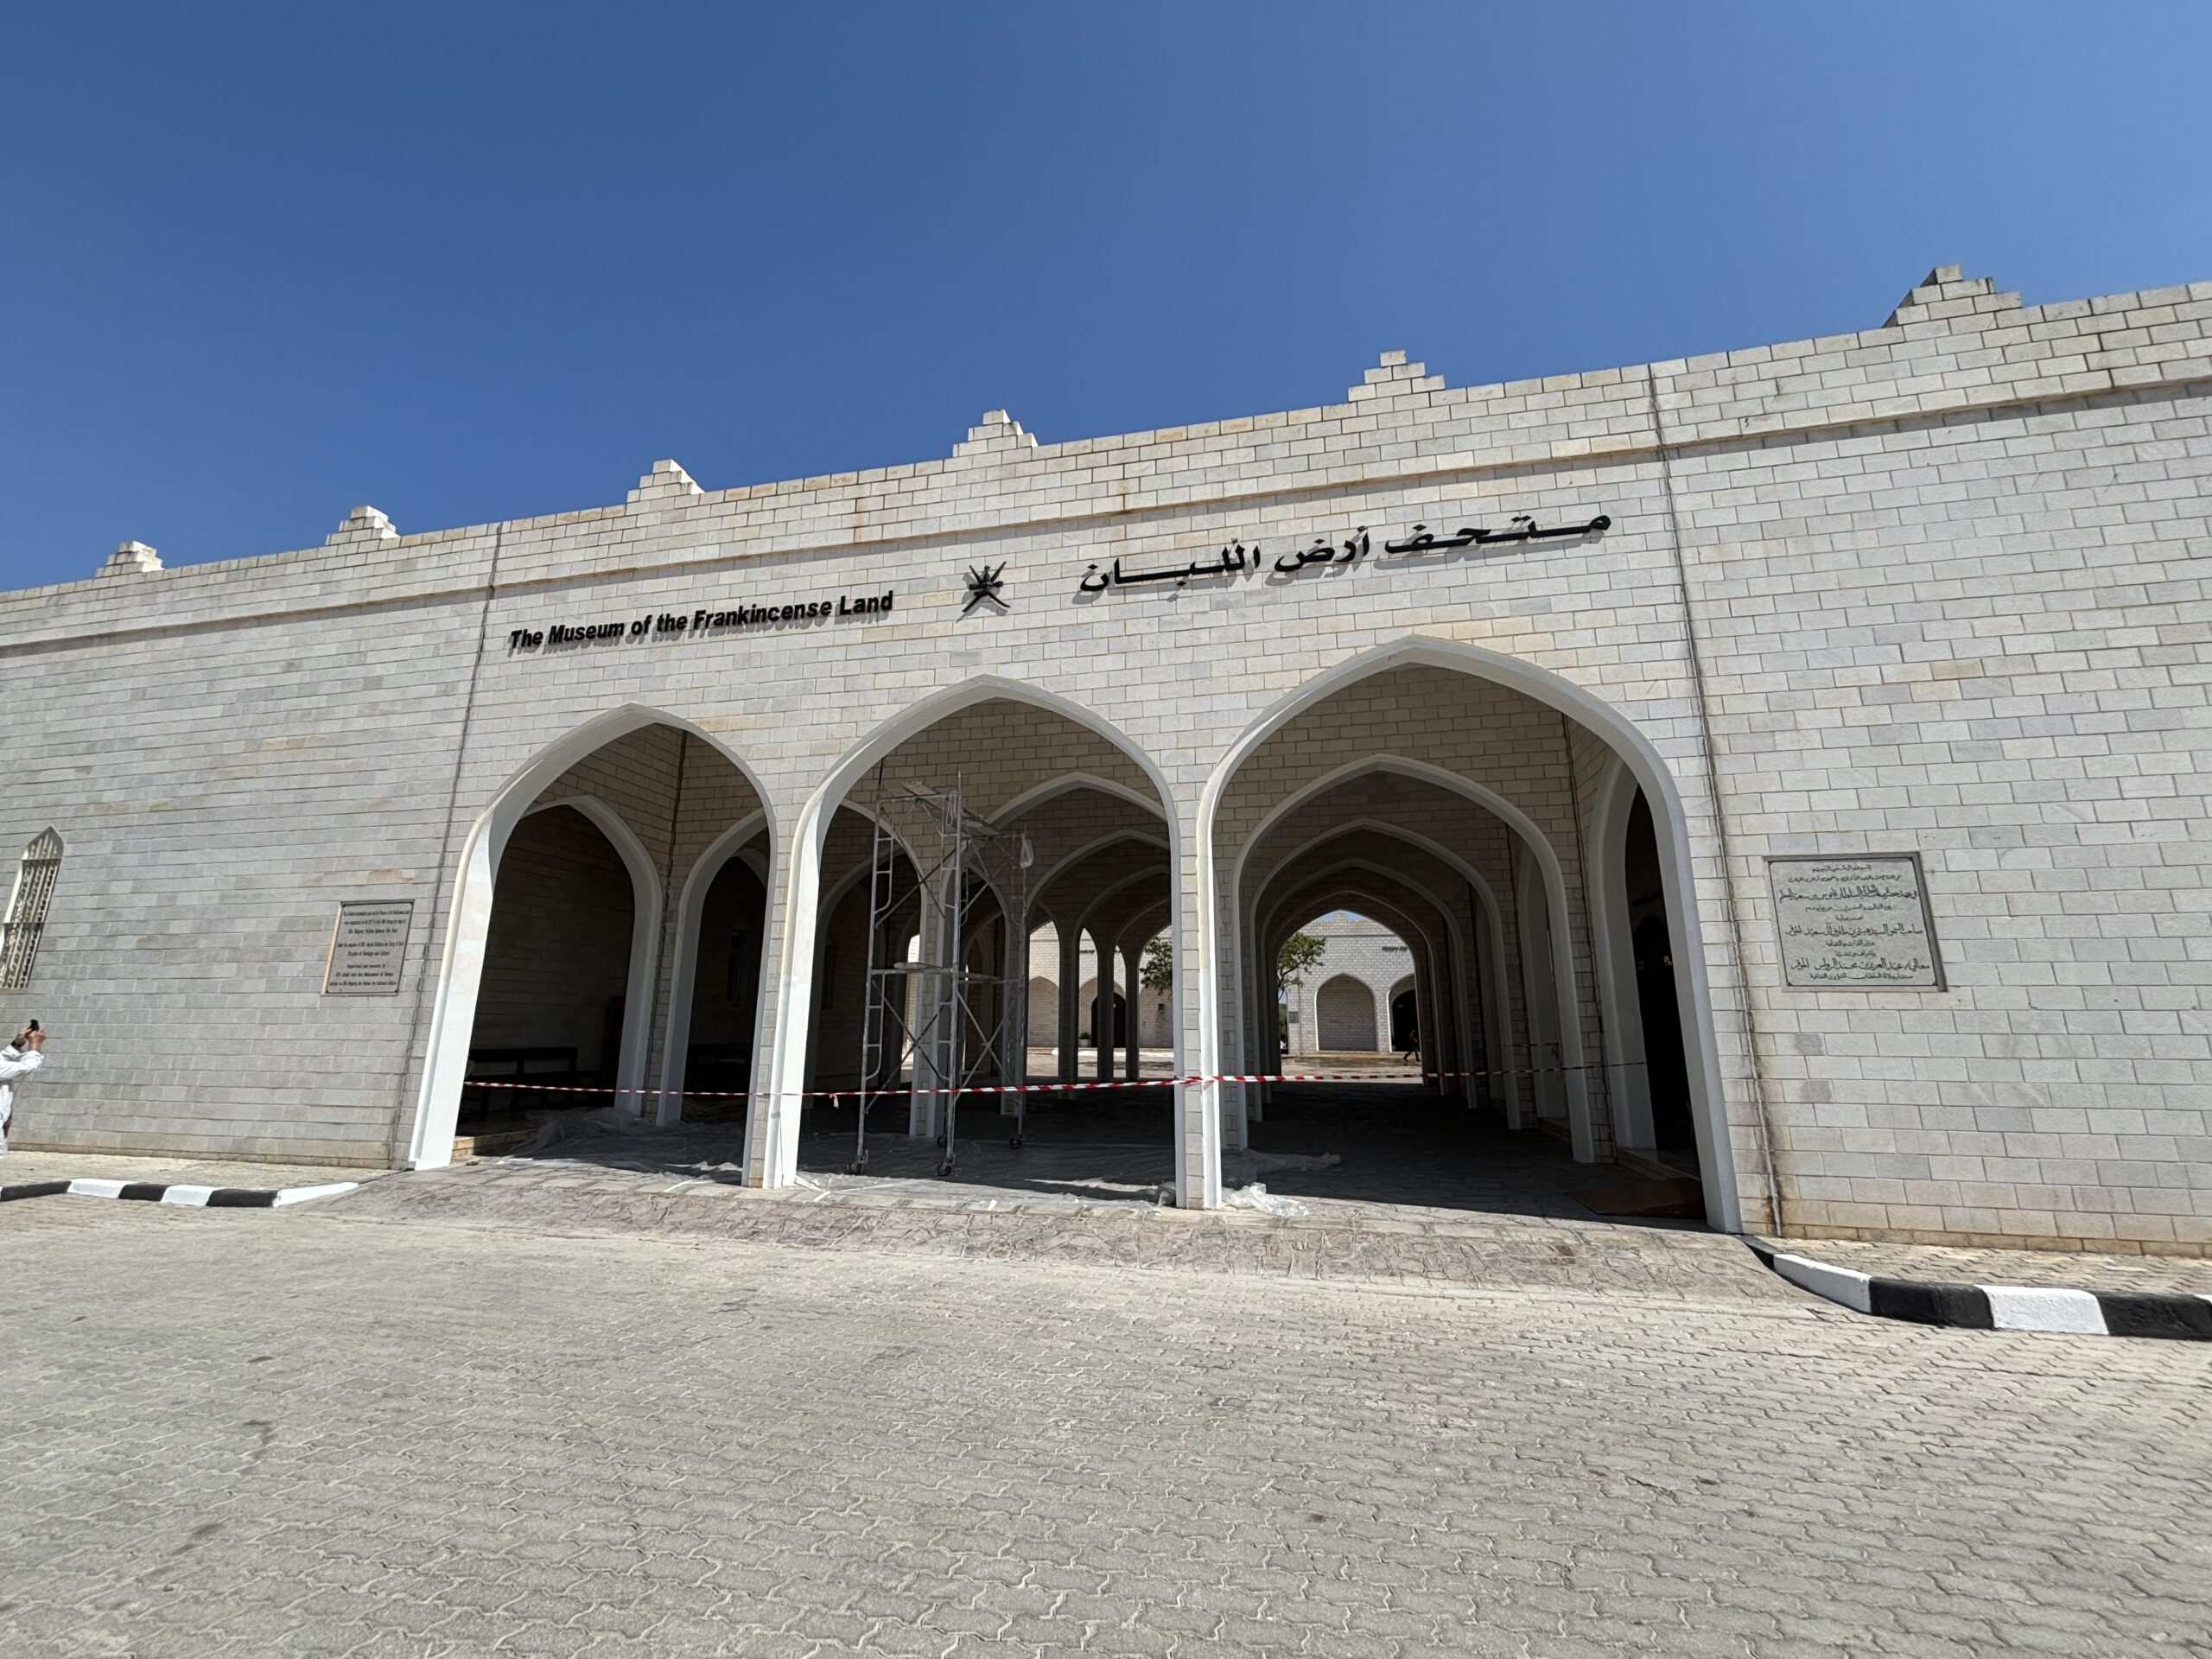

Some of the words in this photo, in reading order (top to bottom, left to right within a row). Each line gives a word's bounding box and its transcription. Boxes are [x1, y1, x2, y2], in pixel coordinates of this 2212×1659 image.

[1274, 525, 1370, 573] أرض
[1384, 516, 1611, 555] متحف
[511, 628, 544, 649] The
[547, 620, 626, 646] Museum
[631, 614, 653, 637] of
[656, 613, 688, 632] the
[693, 601, 833, 631] Frankincense
[839, 590, 893, 616] Land
